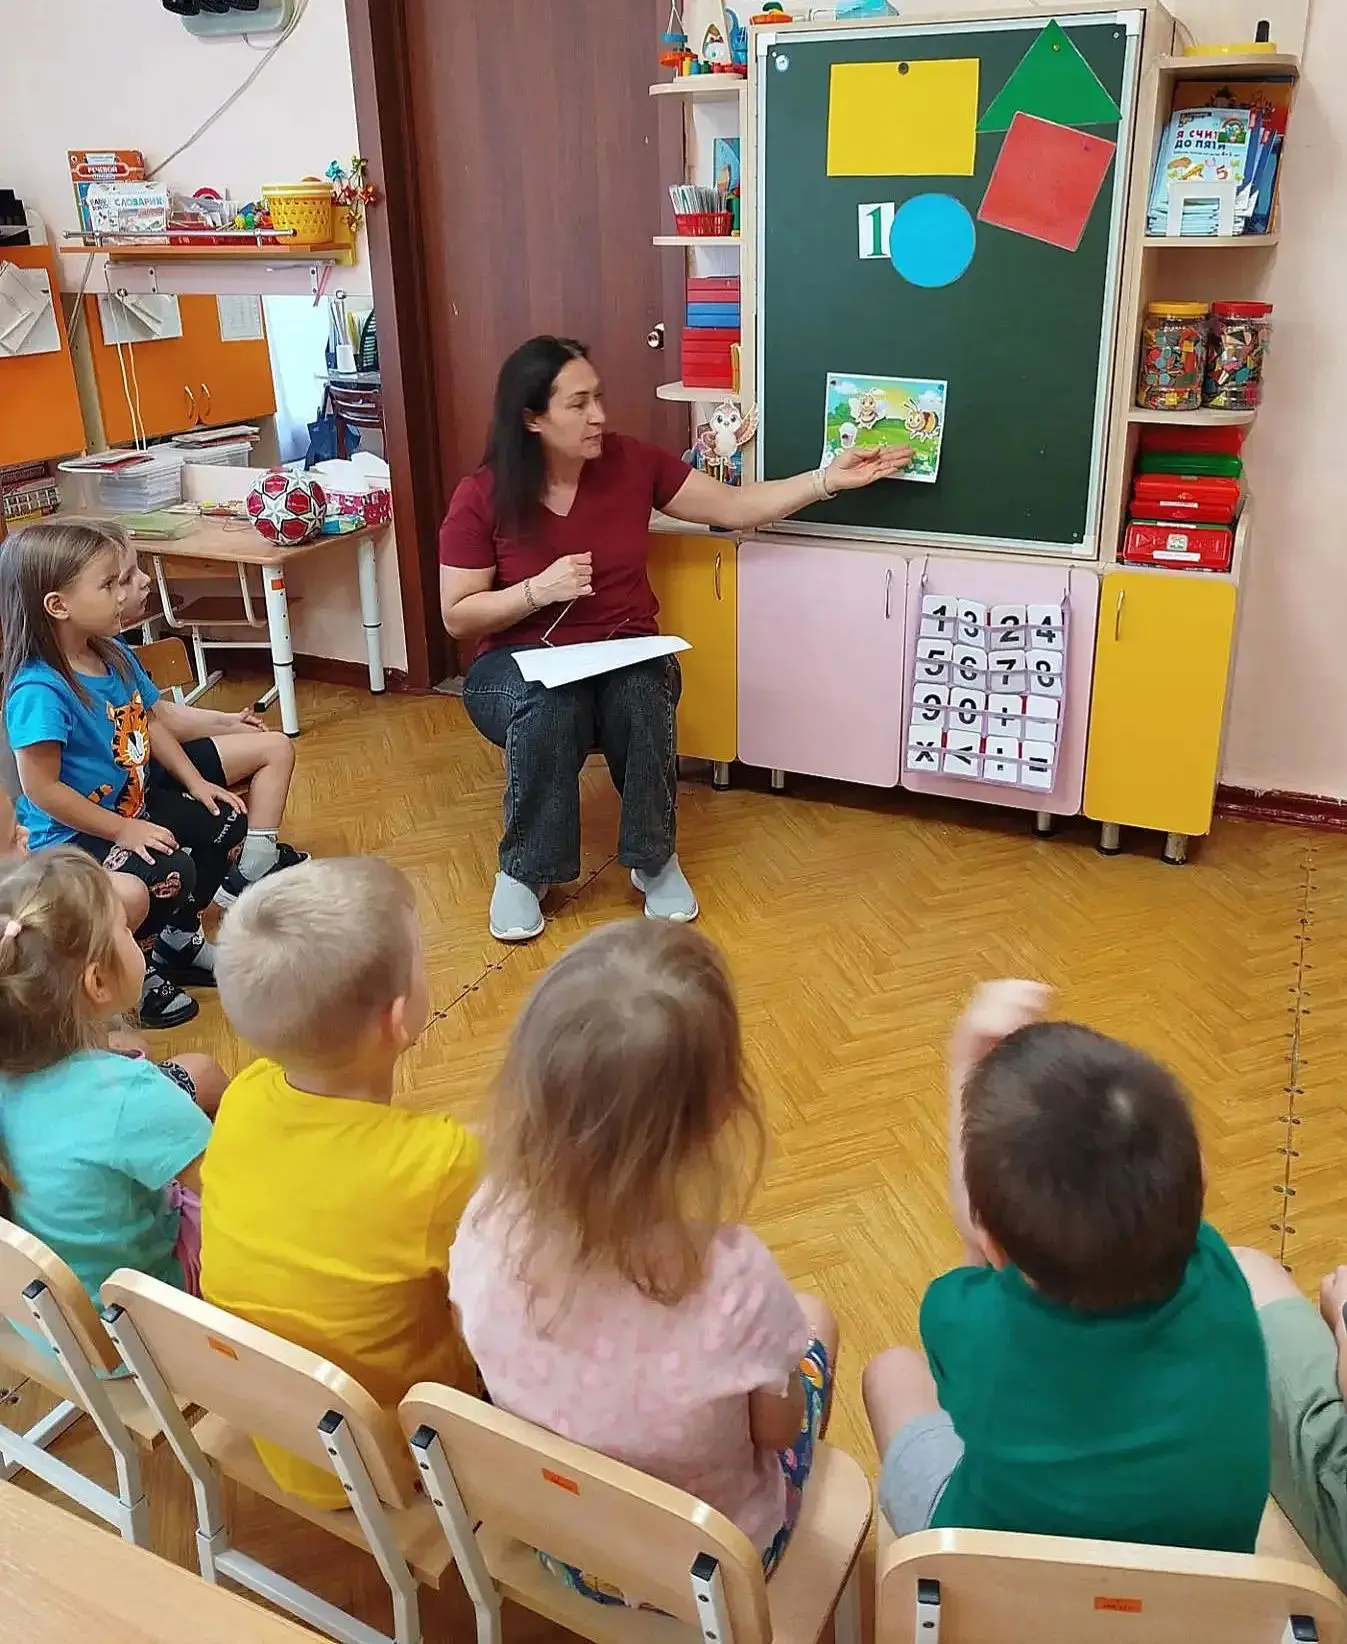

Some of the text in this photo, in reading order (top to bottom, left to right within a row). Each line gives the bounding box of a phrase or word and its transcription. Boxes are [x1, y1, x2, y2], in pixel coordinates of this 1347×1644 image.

[1174, 139, 1192, 149] ДО
[1176, 130, 1184, 139] Я
[1216, 164, 1228, 180] 5
[866, 205, 888, 257] 1
[932, 605, 1056, 643] 1 3 2 4
[924, 649, 1055, 688] 5 6 7 8
[922, 694, 942, 721] 9
[958, 698, 977, 725] 0
